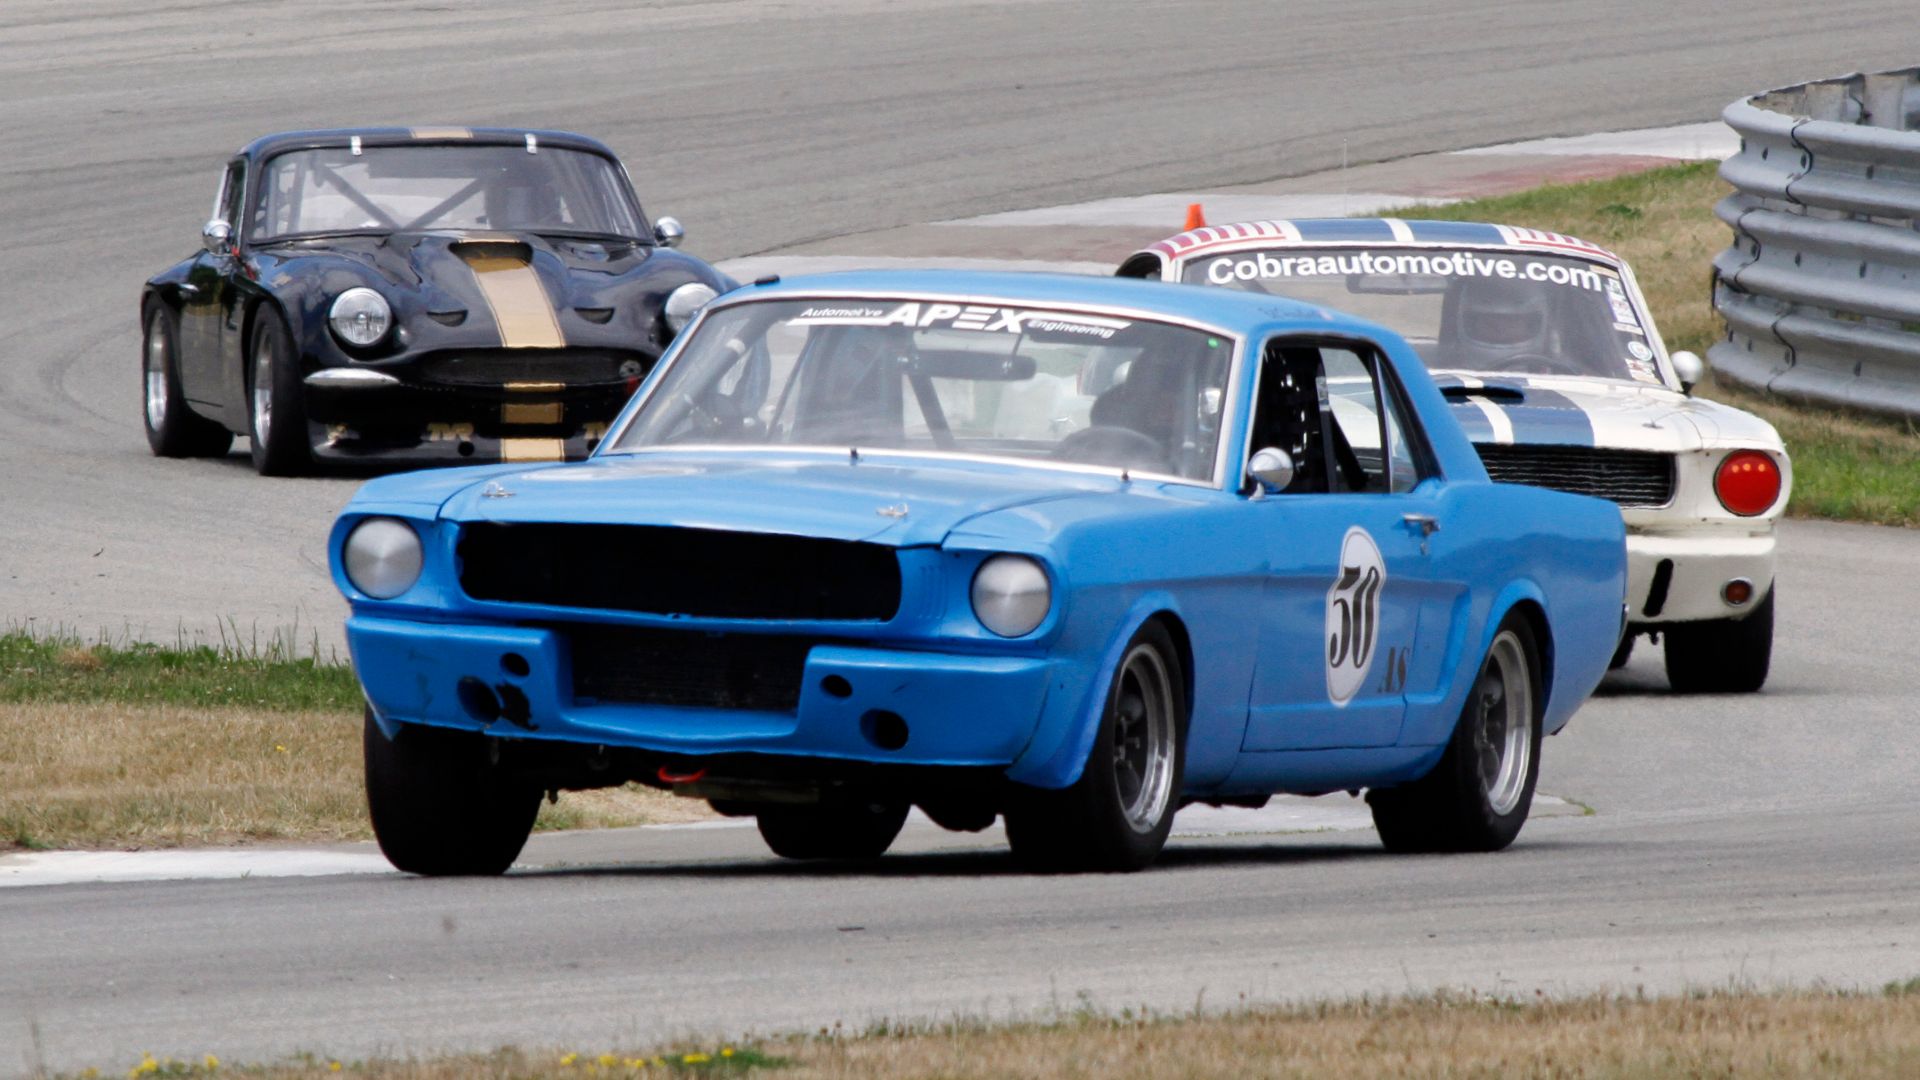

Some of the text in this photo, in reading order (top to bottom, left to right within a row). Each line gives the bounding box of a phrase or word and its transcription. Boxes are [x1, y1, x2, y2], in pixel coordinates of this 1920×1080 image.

[1208, 252, 1601, 292] Cobraautomotive.com
[883, 302, 1022, 334] APEX
[1329, 566, 1380, 669] 50
